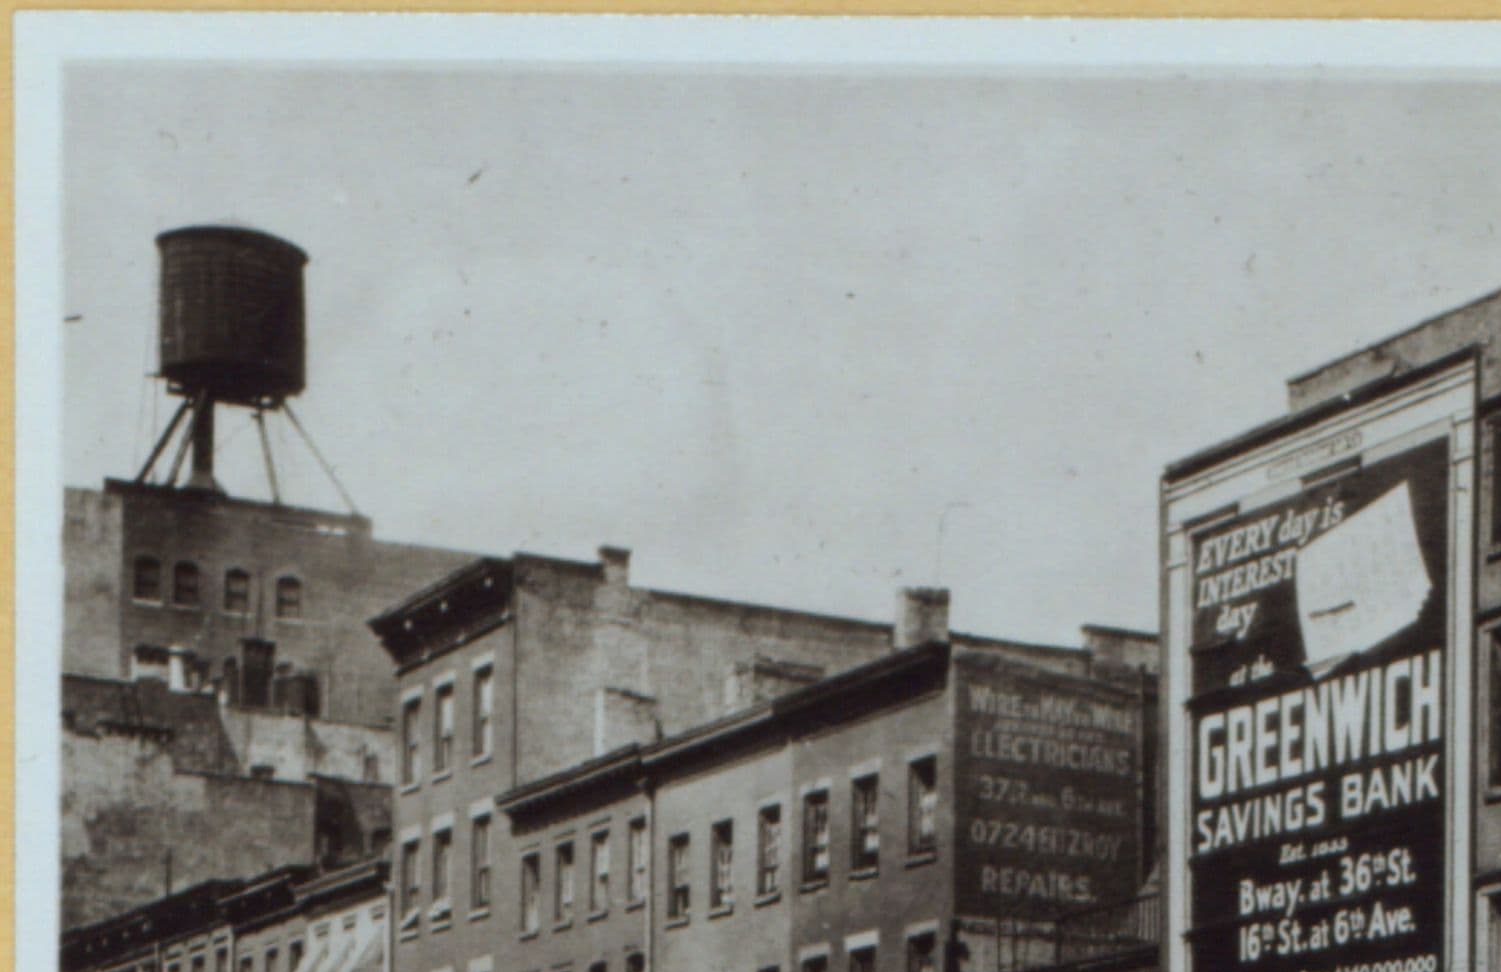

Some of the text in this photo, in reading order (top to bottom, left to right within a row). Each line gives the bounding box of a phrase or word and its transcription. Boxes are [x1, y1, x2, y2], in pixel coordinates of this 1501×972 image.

[1197, 496, 1346, 574] EVERY day is
[1197, 549, 1297, 608] INTEREST
[1216, 602, 1258, 641] day
[1250, 653, 1275, 682] the
[1199, 649, 1441, 800] GREENWICH
[1197, 781, 1325, 852] SAVINGS
[1341, 754, 1439, 819] BANK
[1239, 848, 1417, 918] Bway. at 36th St.
[1239, 901, 1417, 963] 16th St. at 6th Ave.
